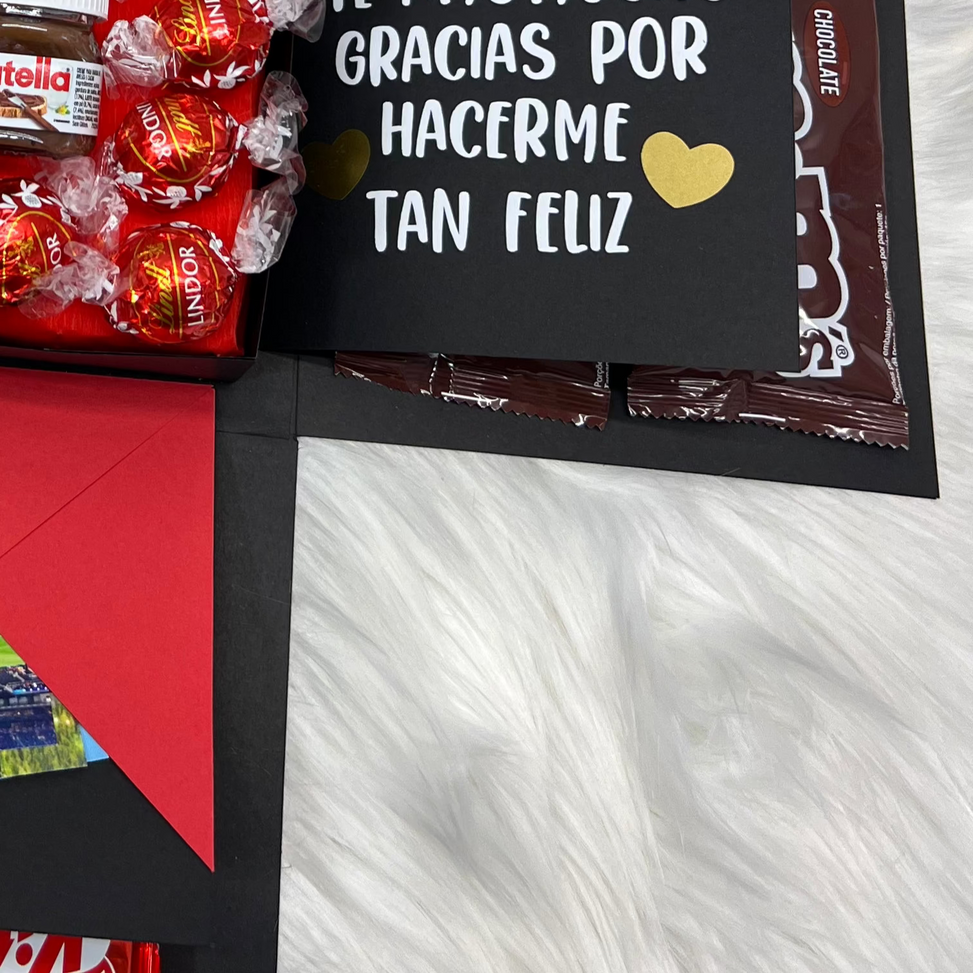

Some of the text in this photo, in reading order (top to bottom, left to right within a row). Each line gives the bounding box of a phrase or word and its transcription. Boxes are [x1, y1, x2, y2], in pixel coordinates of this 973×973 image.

[335, 15, 709, 87] GRACIAS POR
[813, 8, 840, 97] CHOCOLATE
[135, 100, 173, 161] INDOR
[381, 97, 631, 163] HACERME
[366, 188, 633, 254] TAN FELIZ
[178, 245, 205, 327] LINDOR
